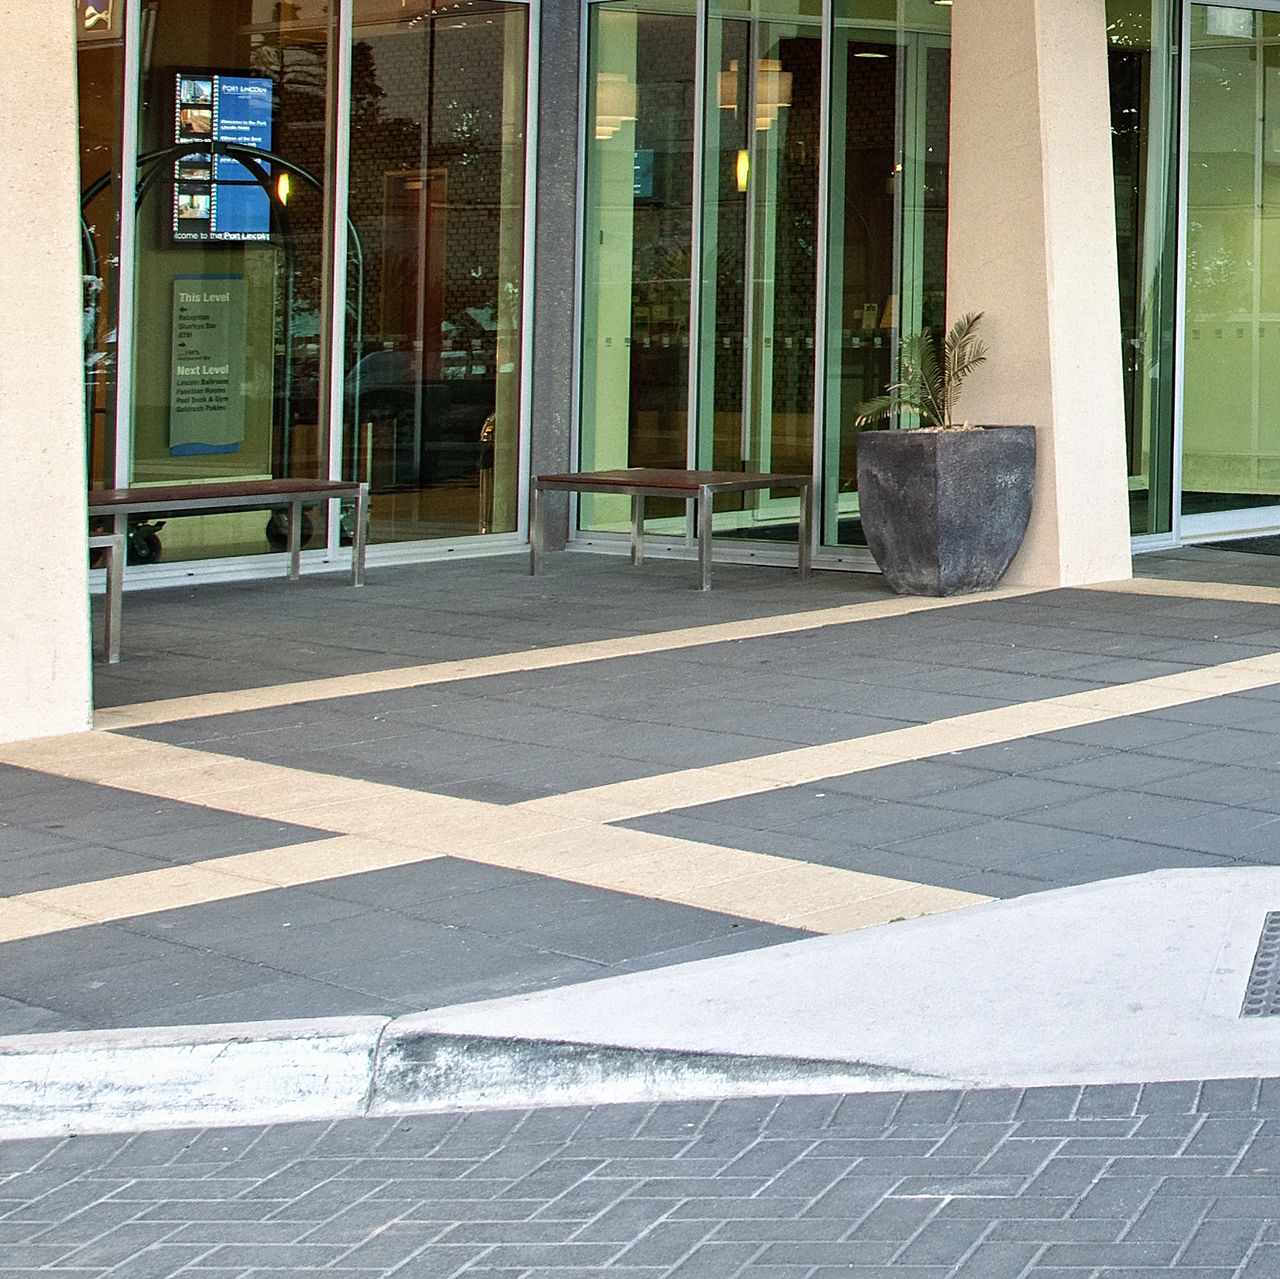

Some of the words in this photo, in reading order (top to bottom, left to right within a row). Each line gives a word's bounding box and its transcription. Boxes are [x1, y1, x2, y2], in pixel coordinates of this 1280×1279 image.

[179, 292, 200, 302] This
[203, 292, 230, 302] Level
[176, 365, 201, 376] Next
[202, 364, 229, 375] Level
